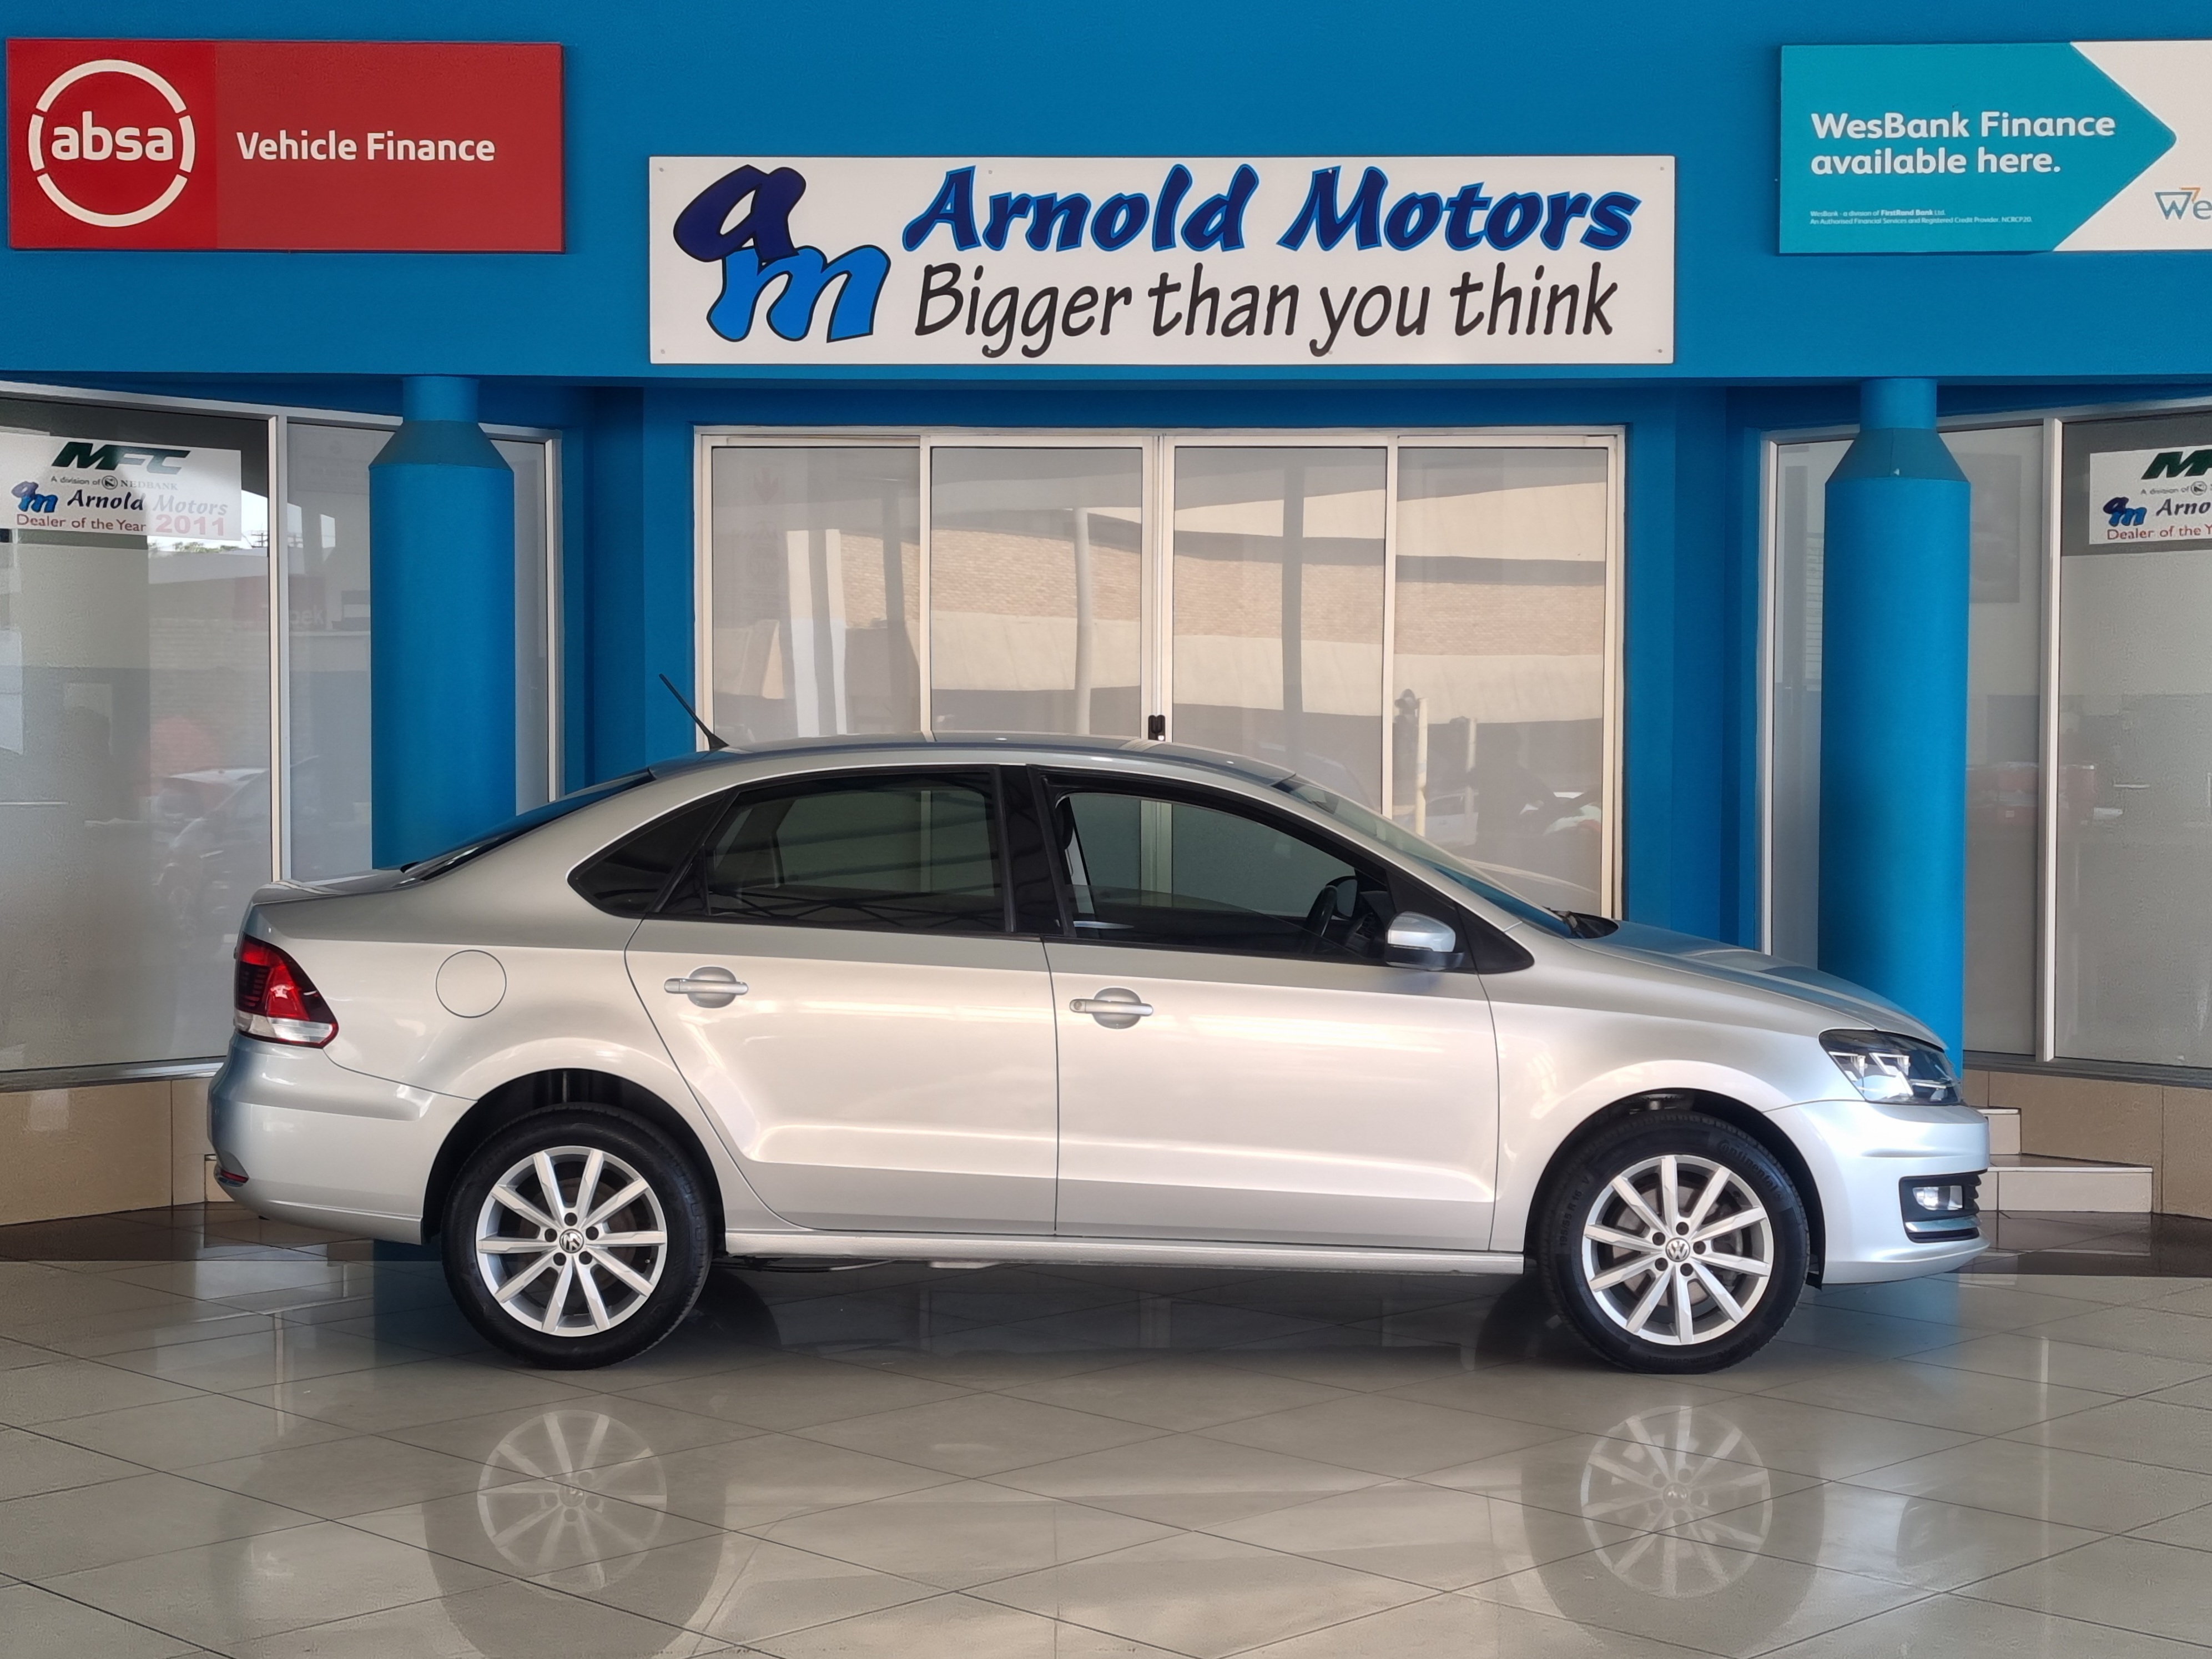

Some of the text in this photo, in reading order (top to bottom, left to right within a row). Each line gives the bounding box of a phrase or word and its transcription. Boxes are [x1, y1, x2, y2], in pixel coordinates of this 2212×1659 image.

[51, 110, 173, 162] absa
[1811, 112, 2115, 139] WesBank Finance
[236, 130, 495, 162] Vehicle Finance
[1811, 147, 2061, 175] available here.
[903, 164, 1642, 252] Arnold Motors
[915, 261, 1618, 358] Bigger than you think
[51, 441, 192, 475] MFC
[120, 480, 179, 491] NEDBANK
[67, 489, 228, 516] Arnold Motors
[16, 513, 147, 532] Dealer of the Year
[155, 514, 225, 536] 2011
[2107, 528, 2155, 540] Dealer
[2160, 526, 2175, 537] of
[2179, 525, 2201, 536] the
